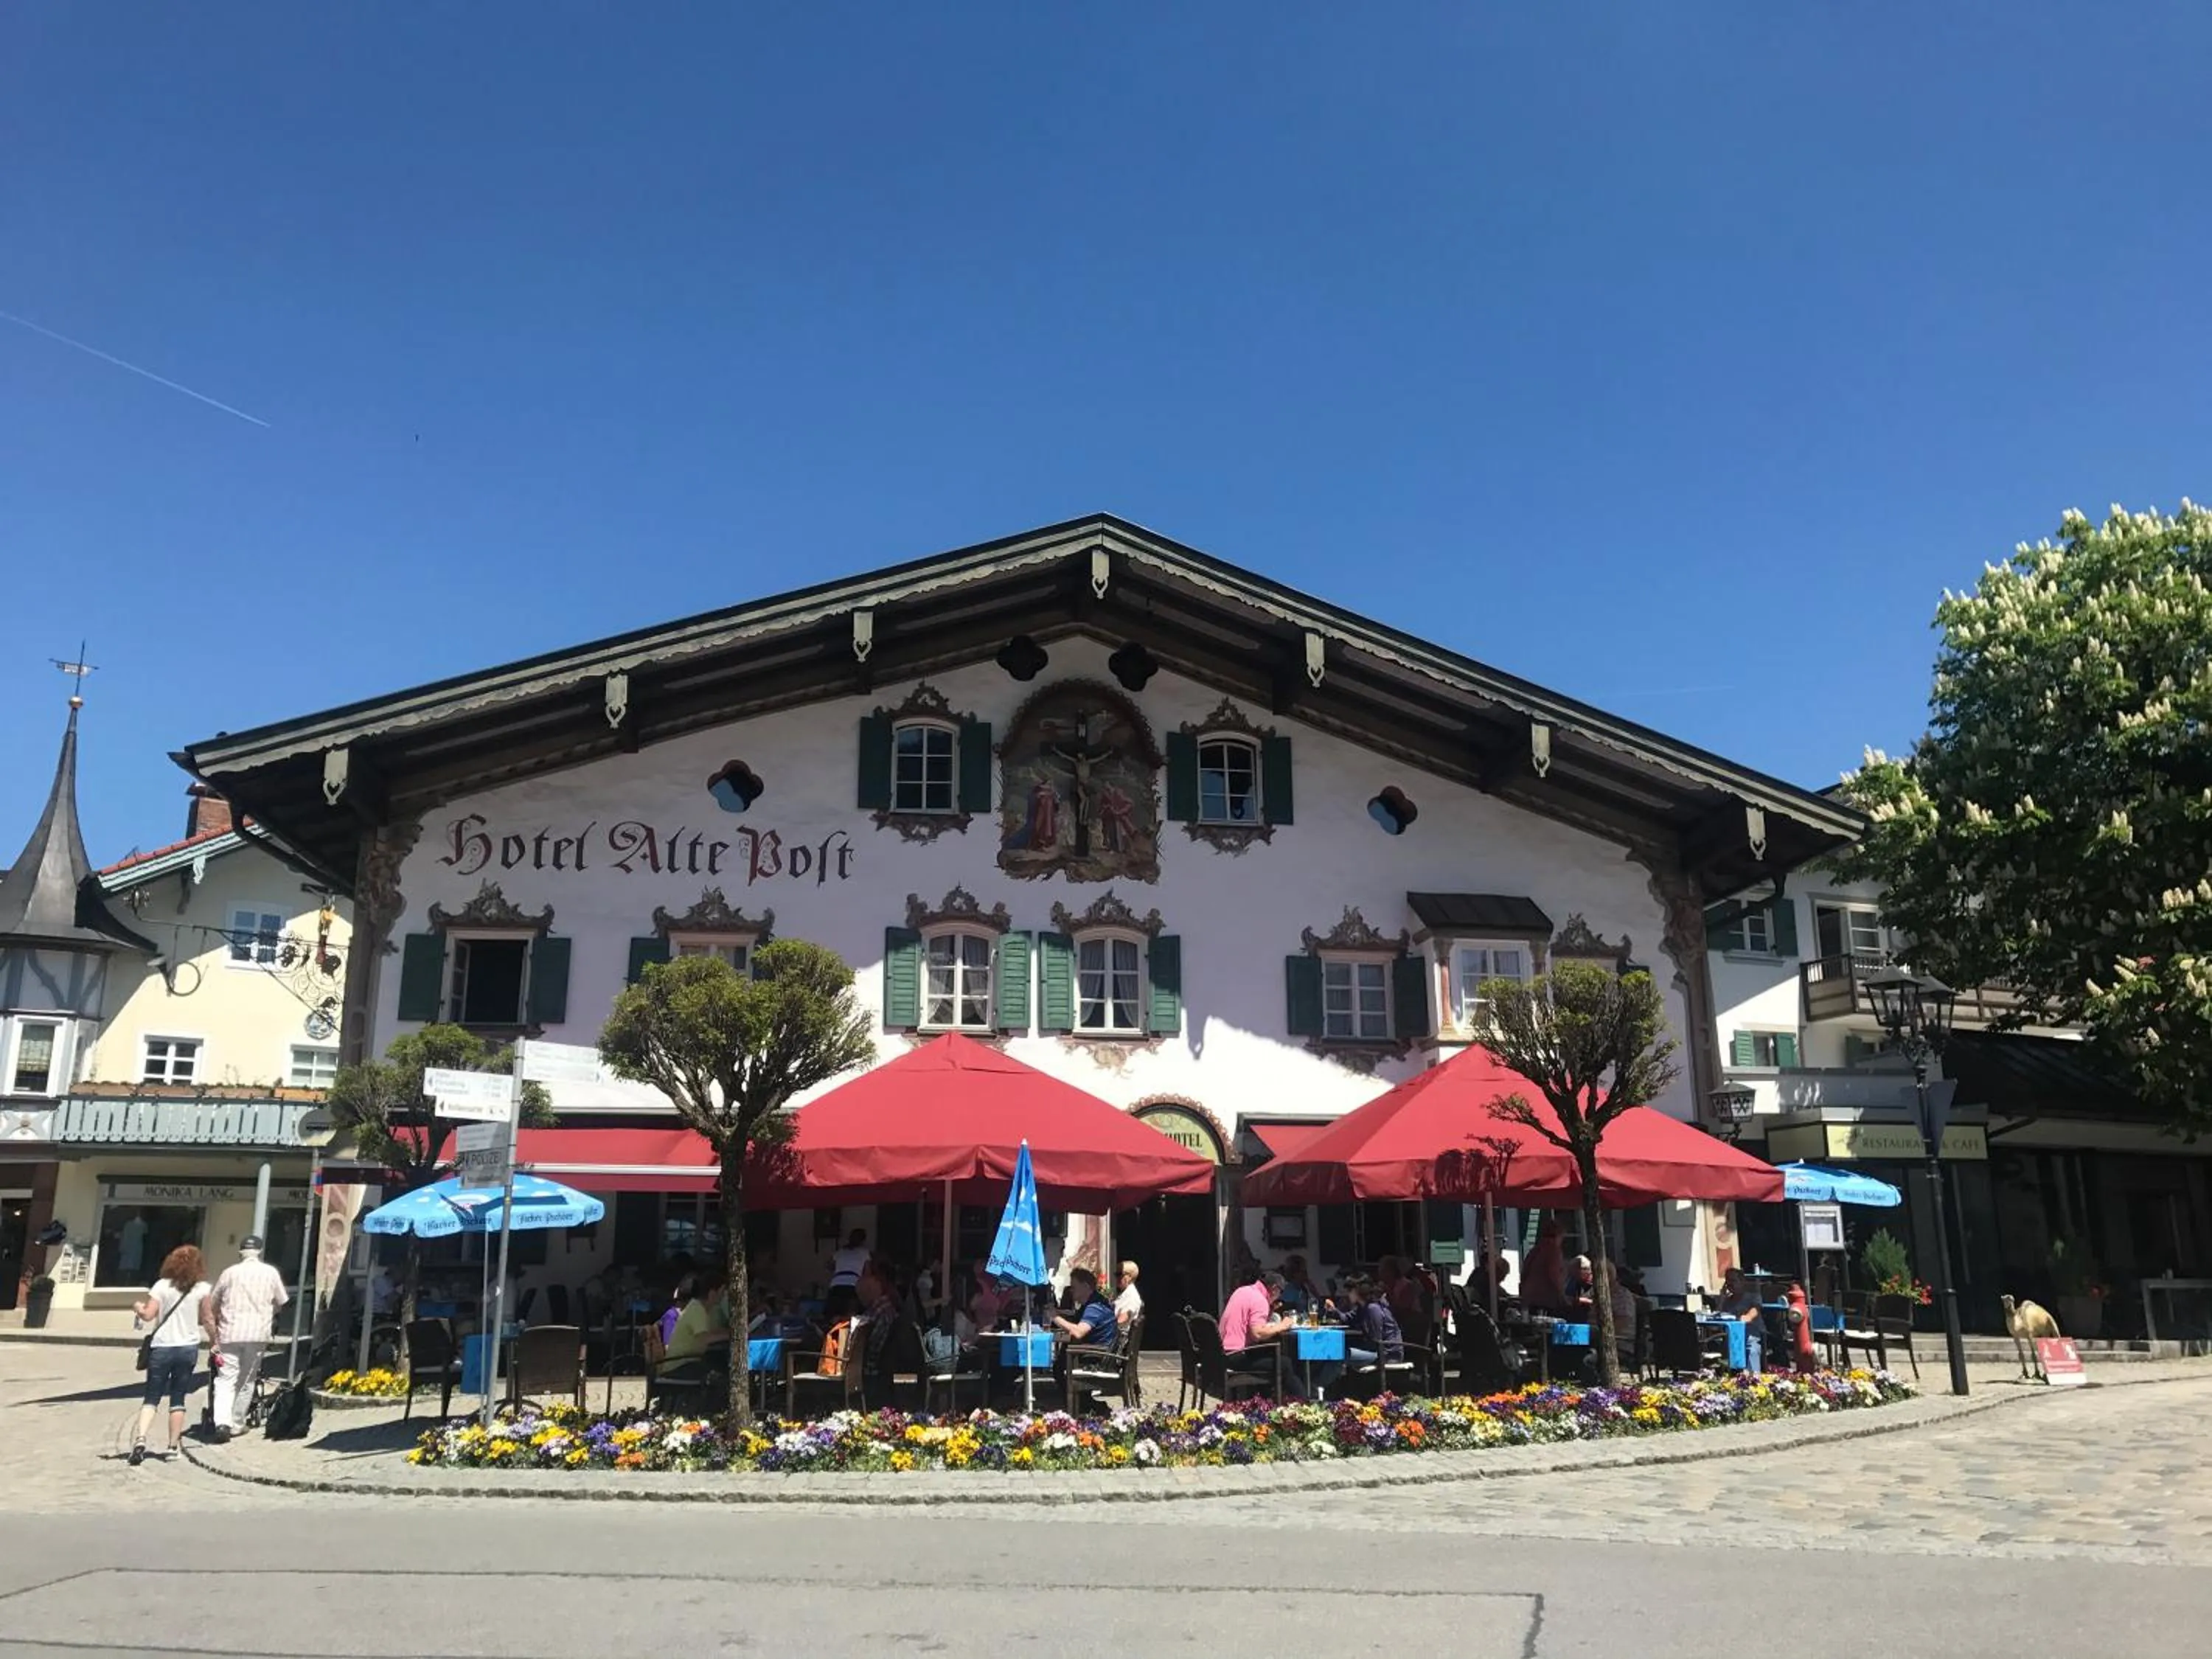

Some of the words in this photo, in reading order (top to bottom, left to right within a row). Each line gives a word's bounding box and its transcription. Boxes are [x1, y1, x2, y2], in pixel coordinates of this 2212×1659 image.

[437, 813, 597, 875] Hotel
[609, 821, 730, 875] Alte
[1164, 1132, 1203, 1148] OTEL
[1862, 1138, 1924, 1150] RESTAURA
[144, 1186, 192, 1198] MONIKA
[199, 1186, 234, 1200] LANG
